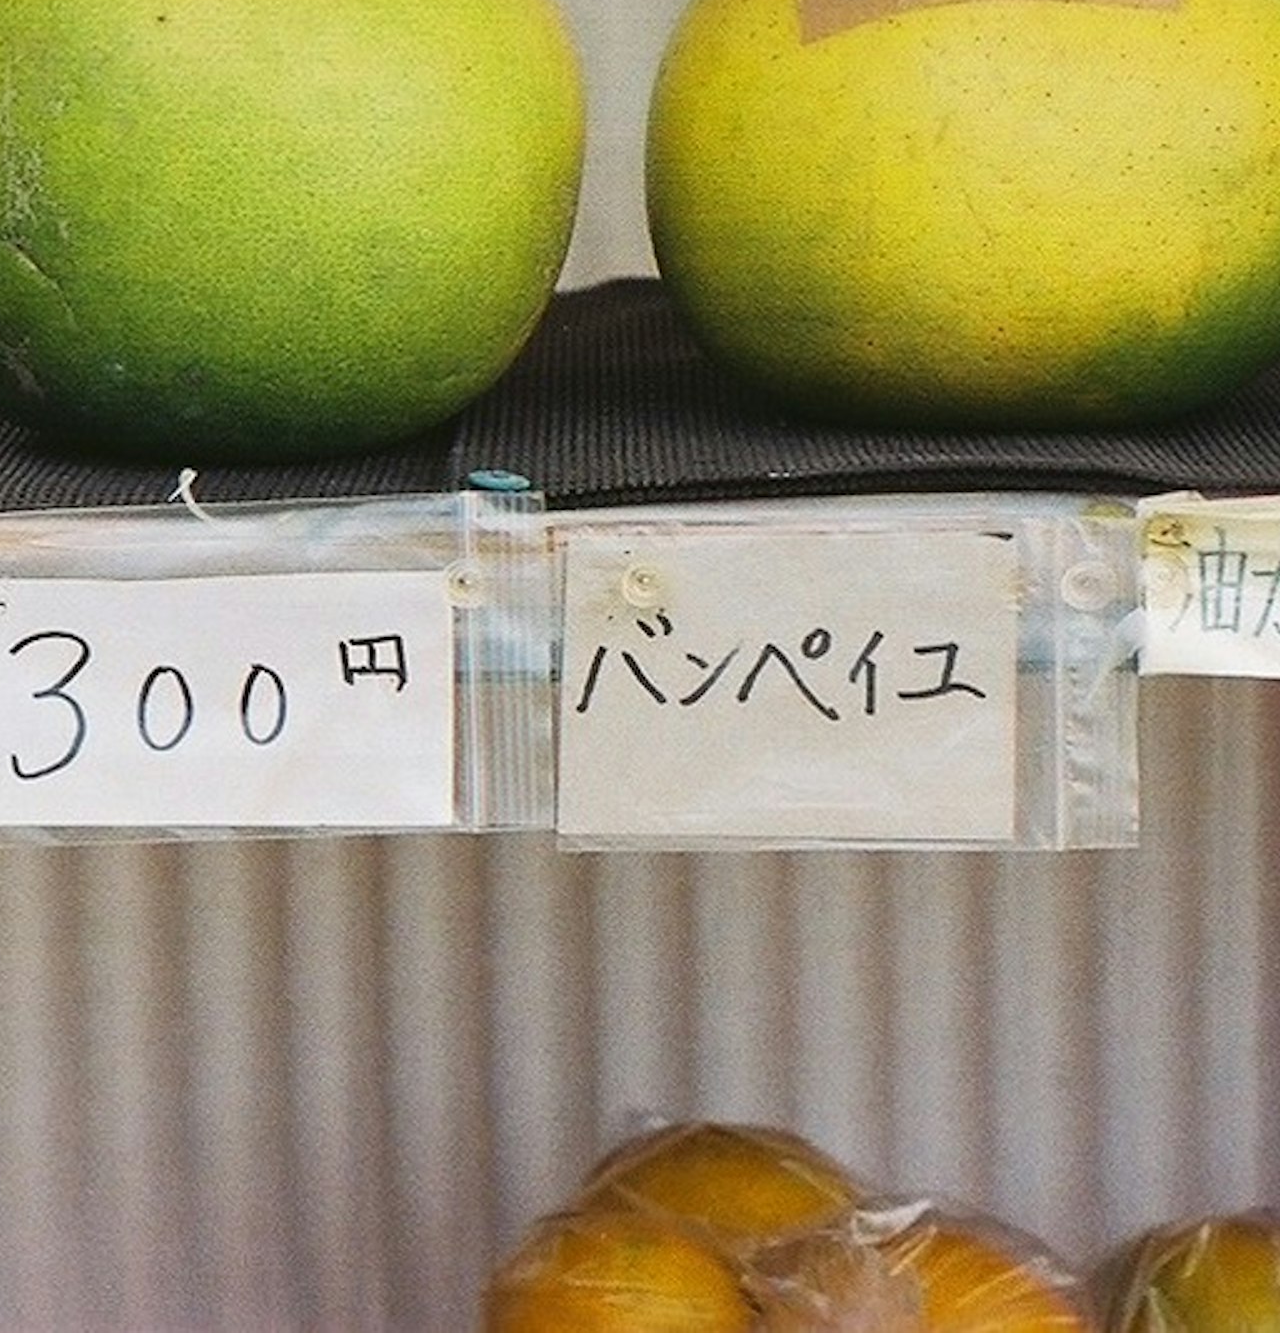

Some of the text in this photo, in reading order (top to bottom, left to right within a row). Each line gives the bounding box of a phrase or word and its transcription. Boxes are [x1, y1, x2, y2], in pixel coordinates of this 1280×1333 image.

[8, 629, 408, 780] 300円
[573, 611, 988, 722] バンペイユ
